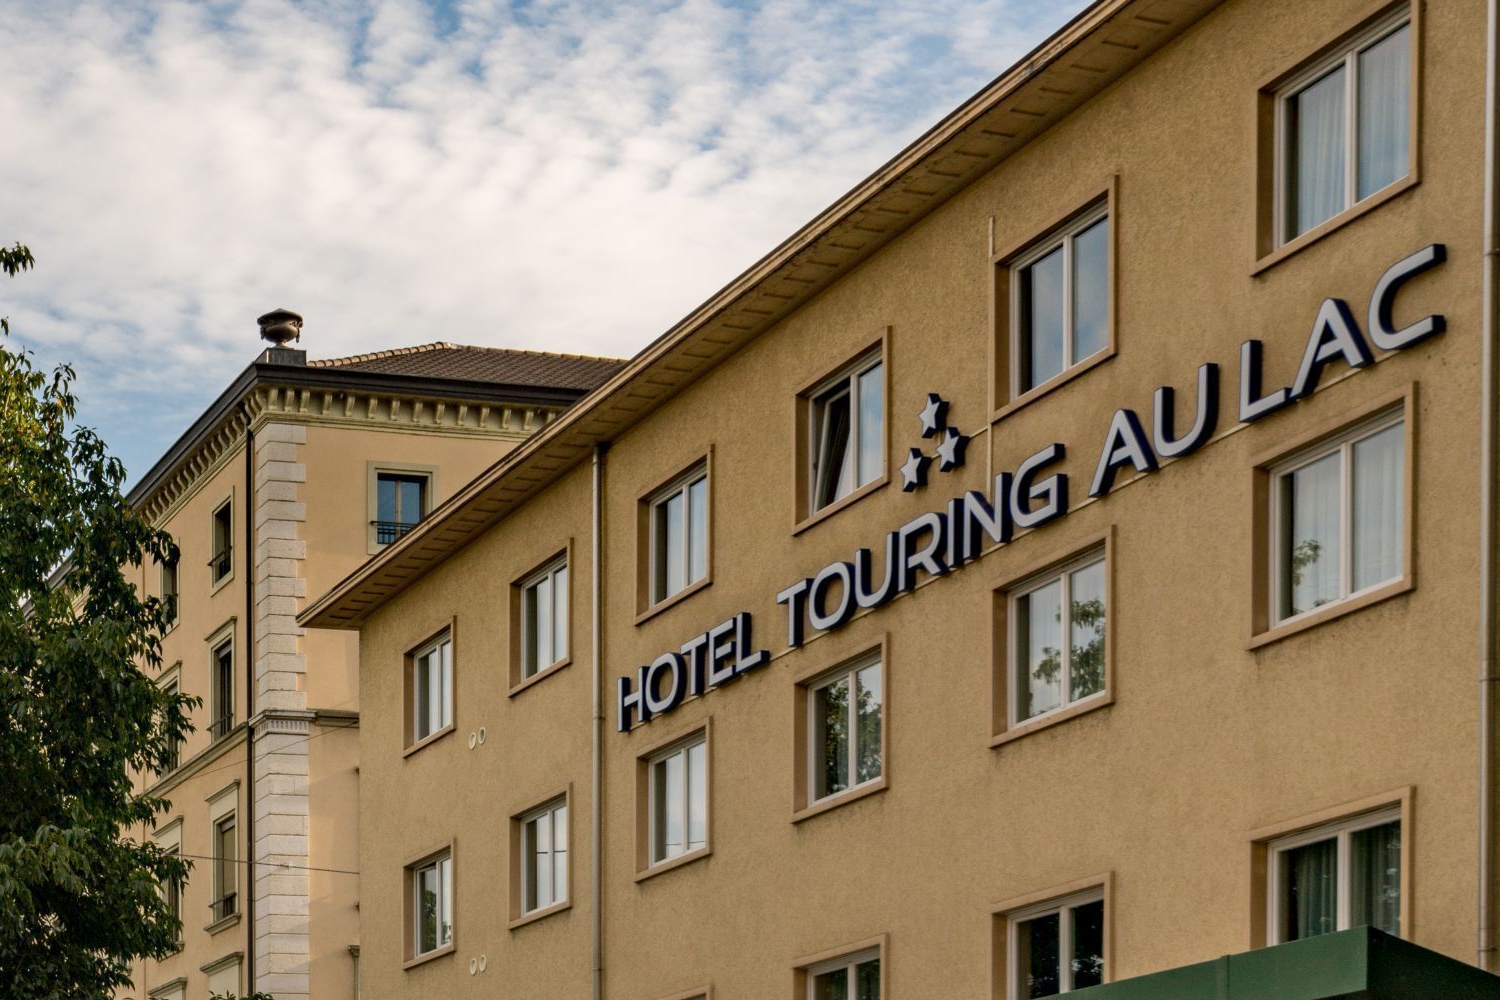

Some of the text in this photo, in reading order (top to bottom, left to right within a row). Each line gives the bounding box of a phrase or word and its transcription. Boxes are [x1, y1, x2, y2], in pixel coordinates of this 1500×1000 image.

[617, 242, 1448, 733] HOTEL TOURING AU LAC
